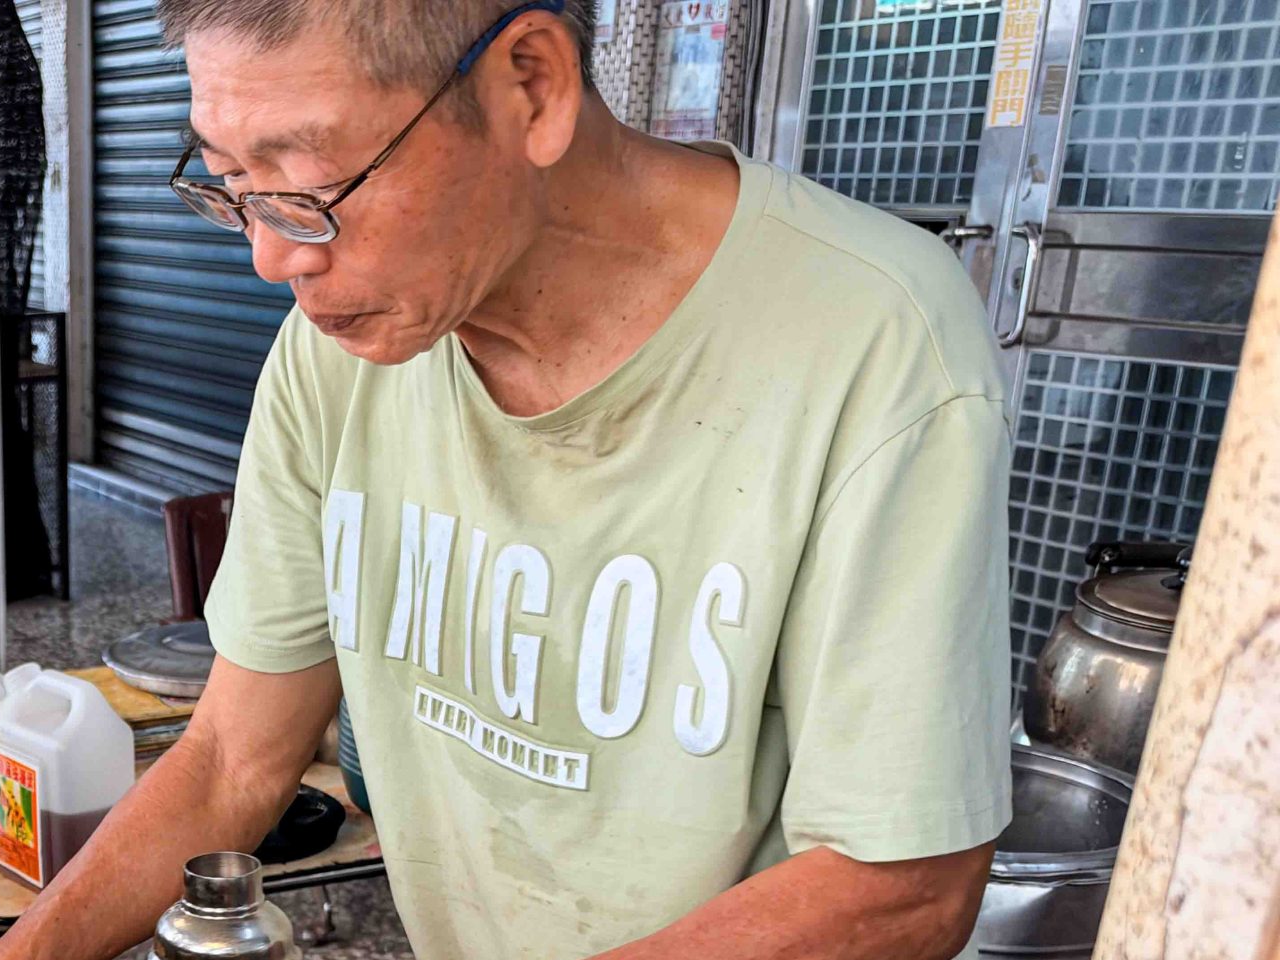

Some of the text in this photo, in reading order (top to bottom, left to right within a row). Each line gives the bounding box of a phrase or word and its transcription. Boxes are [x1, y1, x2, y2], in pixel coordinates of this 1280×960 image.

[989, 0, 1040, 127] 隨手關門
[322, 488, 748, 757] AMIGOS
[417, 690, 582, 786] EVERY MOMENT
